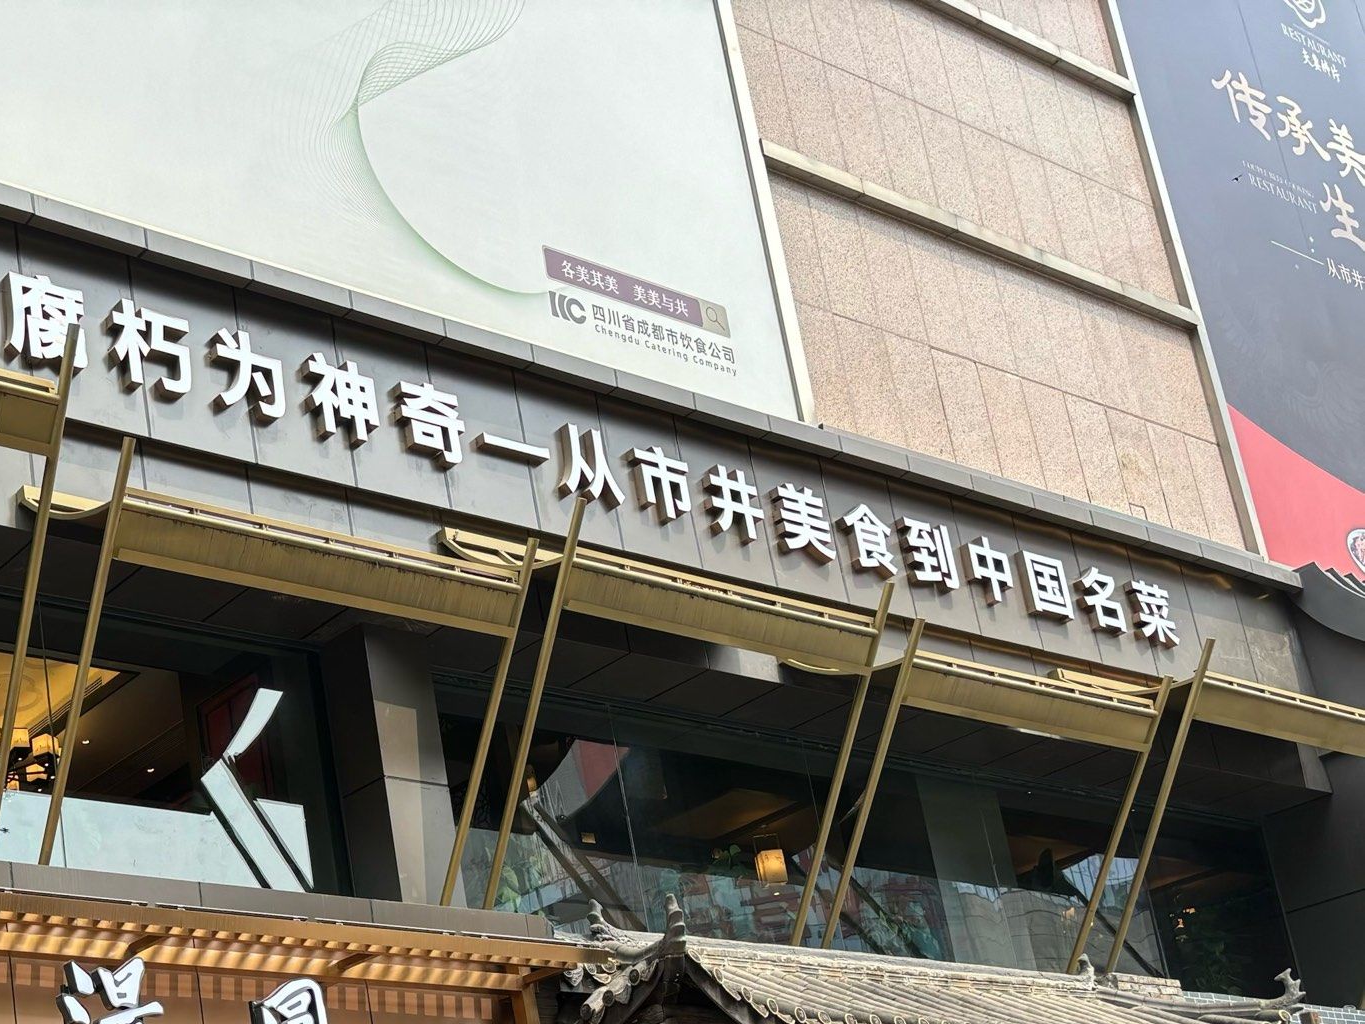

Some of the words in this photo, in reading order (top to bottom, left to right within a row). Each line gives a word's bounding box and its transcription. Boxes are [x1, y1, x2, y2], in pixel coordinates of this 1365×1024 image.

[561, 260, 619, 295] 各美其美
[633, 284, 689, 318] 美美与共
[592, 304, 735, 364] 四川省成都市饮食公司
[595, 324, 640, 346] Chengdu
[645, 340, 689, 362] Catering
[693, 355, 737, 377] Company
